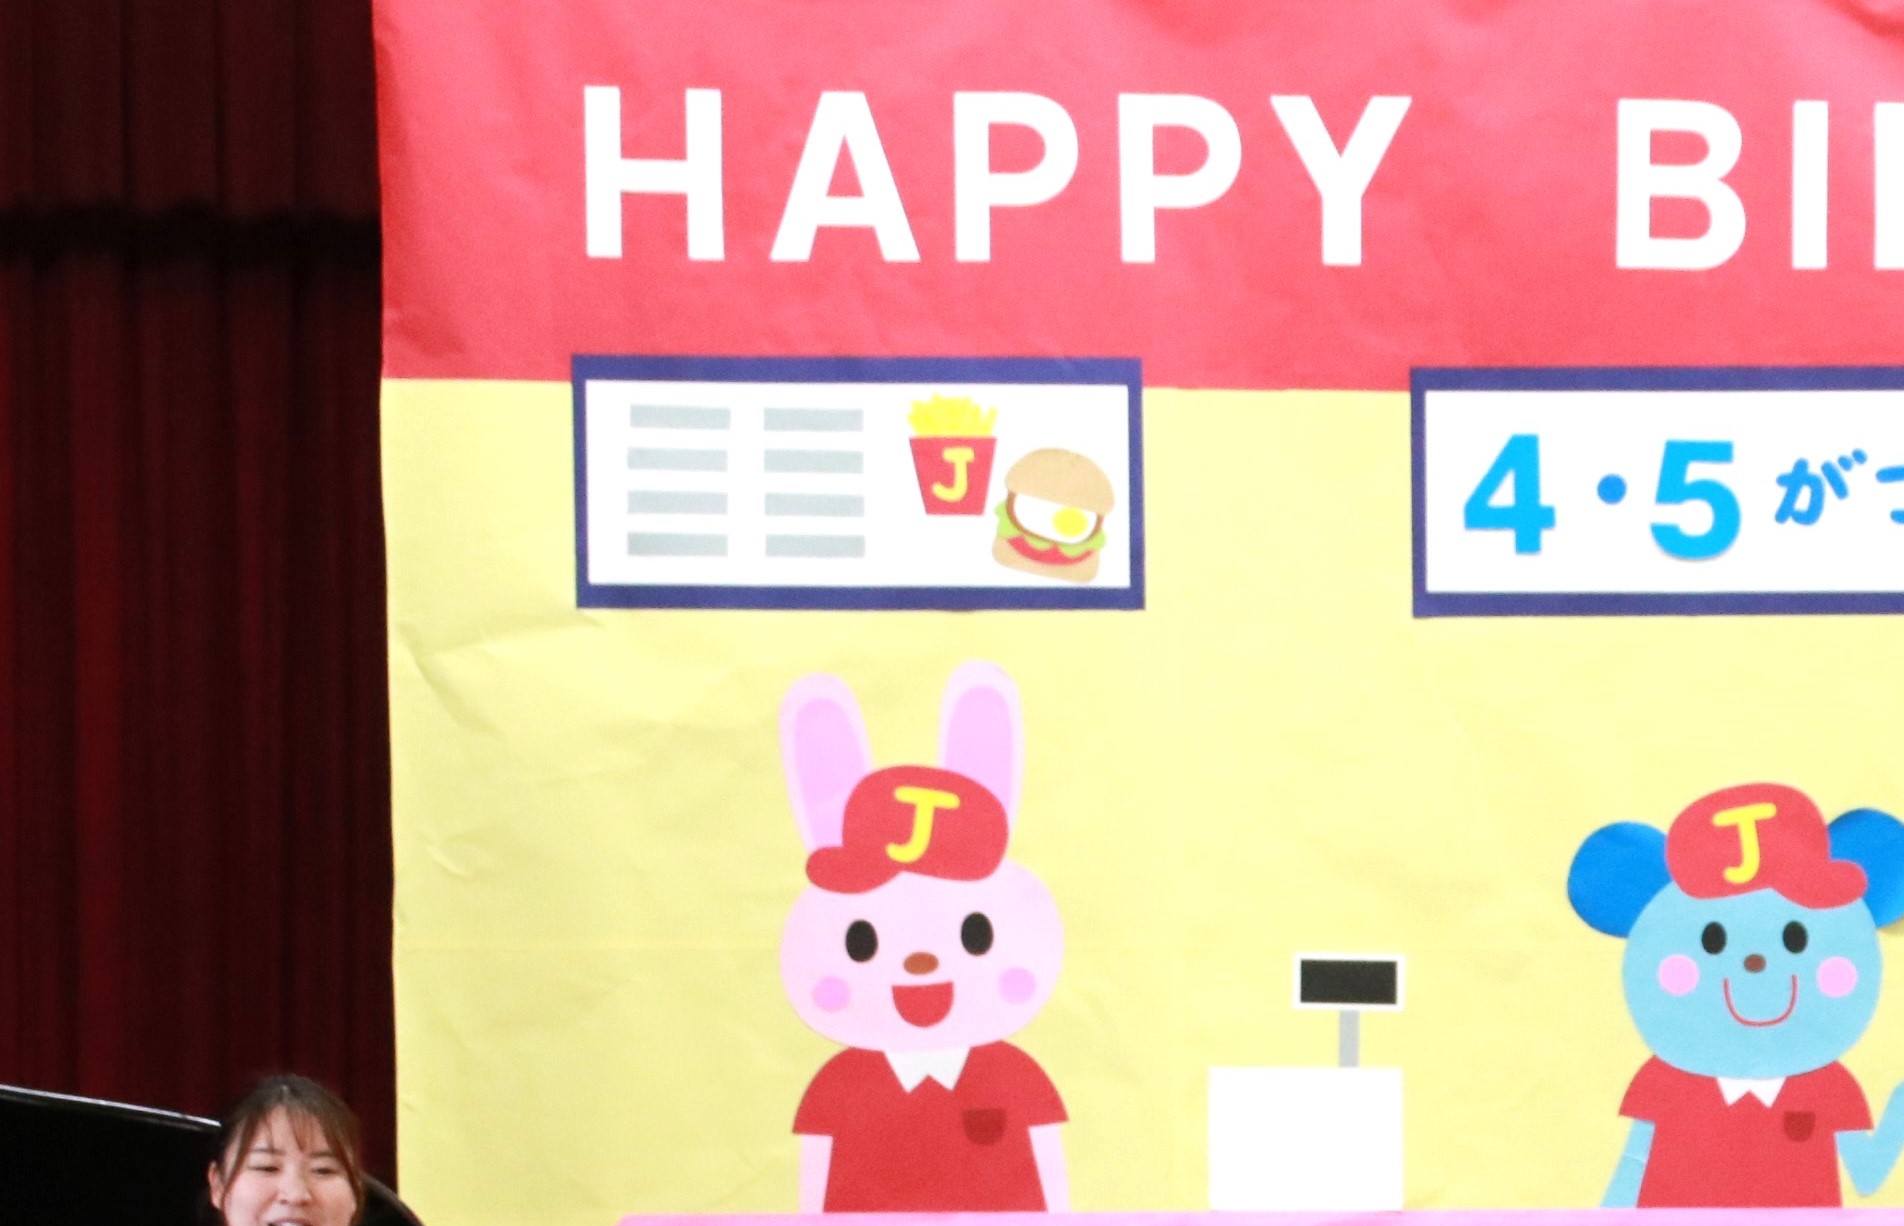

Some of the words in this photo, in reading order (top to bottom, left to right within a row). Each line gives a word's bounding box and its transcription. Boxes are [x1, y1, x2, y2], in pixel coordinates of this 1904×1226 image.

[582, 85, 1412, 266] HAPPY
[932, 447, 975, 502] J
[886, 786, 960, 862] J
[1712, 803, 1777, 884] J
